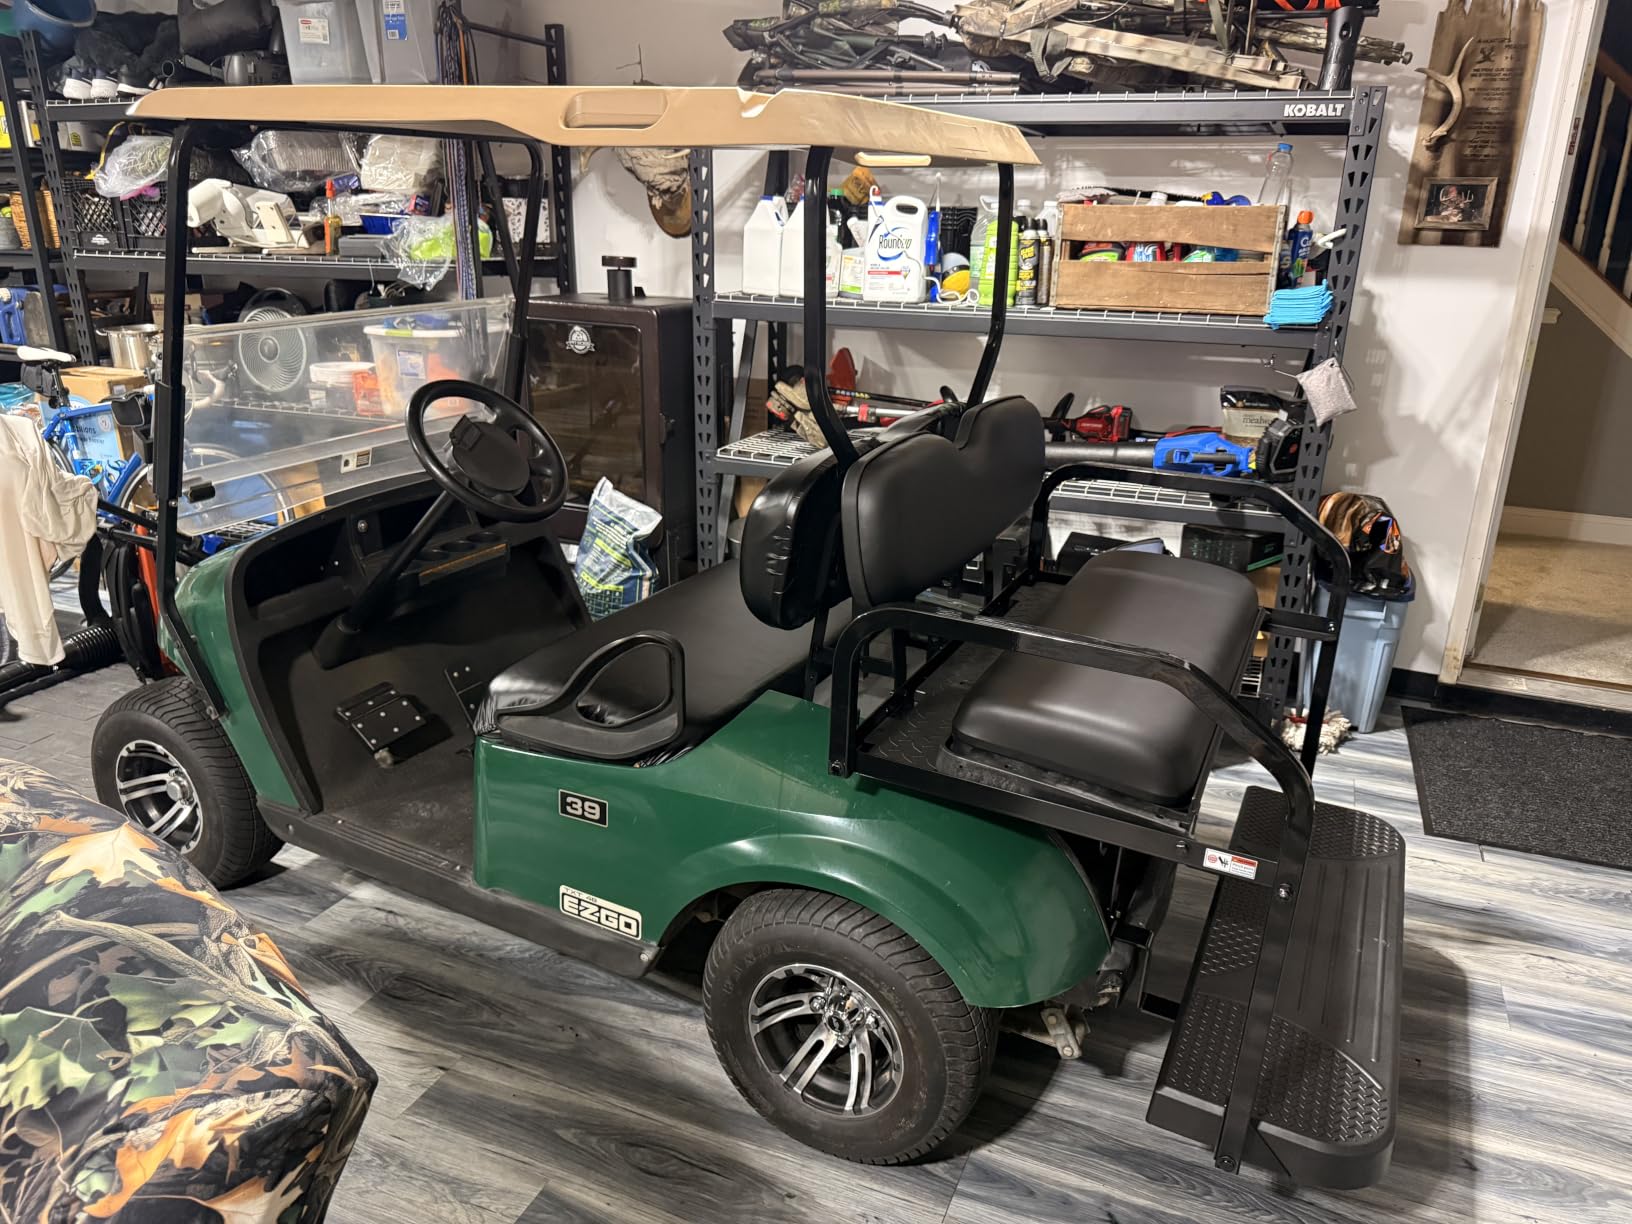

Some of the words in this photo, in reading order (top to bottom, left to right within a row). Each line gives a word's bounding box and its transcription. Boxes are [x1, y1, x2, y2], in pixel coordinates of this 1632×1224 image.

[1283, 103, 1345, 117] KOBALT
[1242, 415, 1271, 425] mealw
[566, 796, 601, 820] 39
[564, 887, 583, 898] TXT
[563, 894, 638, 937] EZGO
